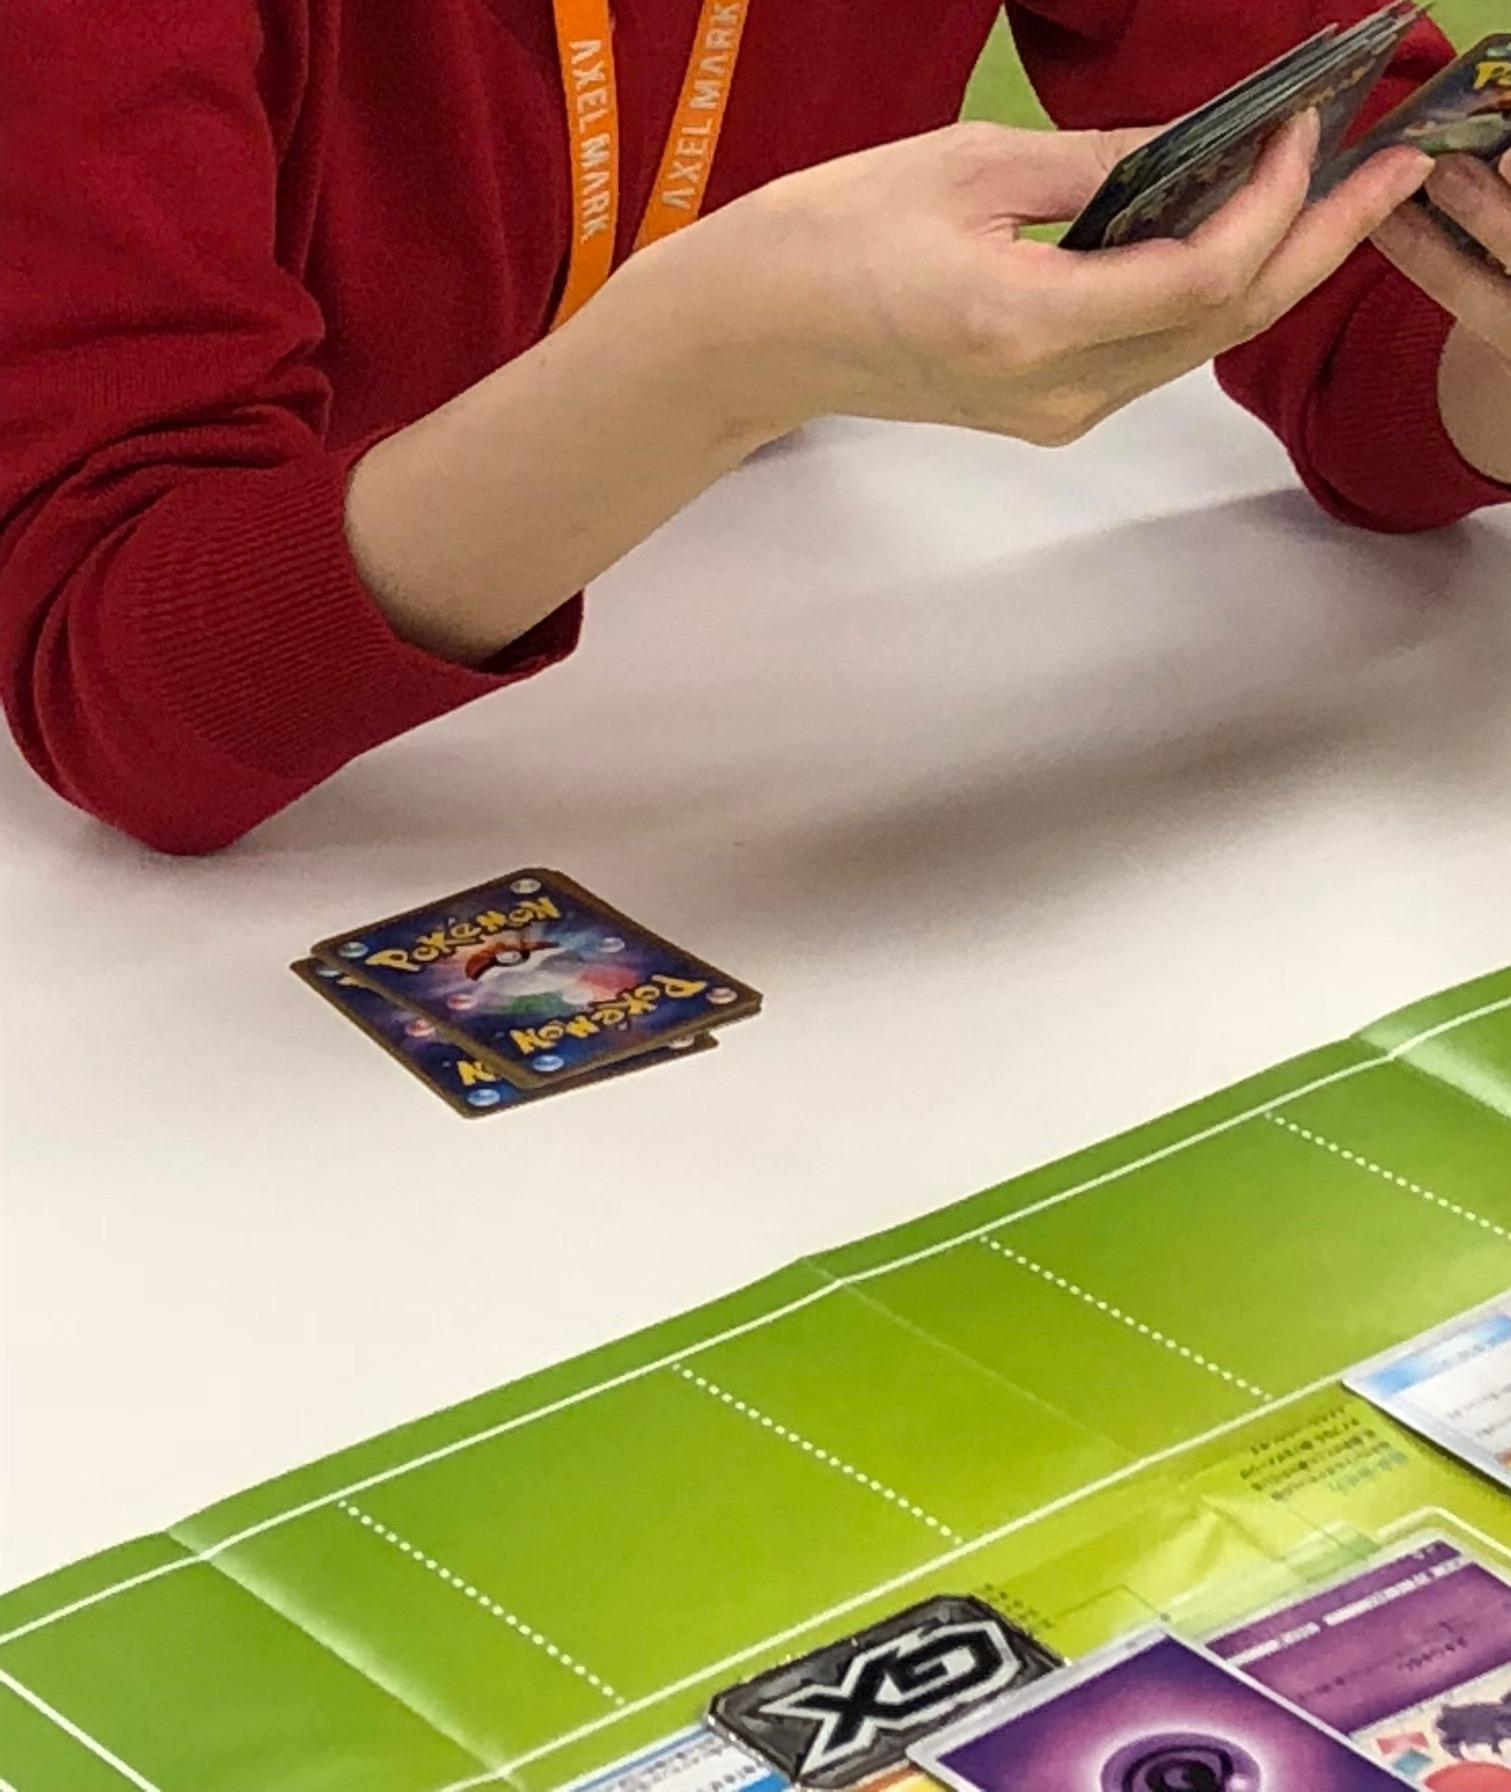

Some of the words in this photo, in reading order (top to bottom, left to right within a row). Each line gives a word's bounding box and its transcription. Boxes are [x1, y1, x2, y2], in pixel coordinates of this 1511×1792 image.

[569, 39, 608, 134] AXEL
[660, 118, 713, 210] AXEL
[689, 1, 741, 110] MARK
[580, 133, 611, 244] MARK
